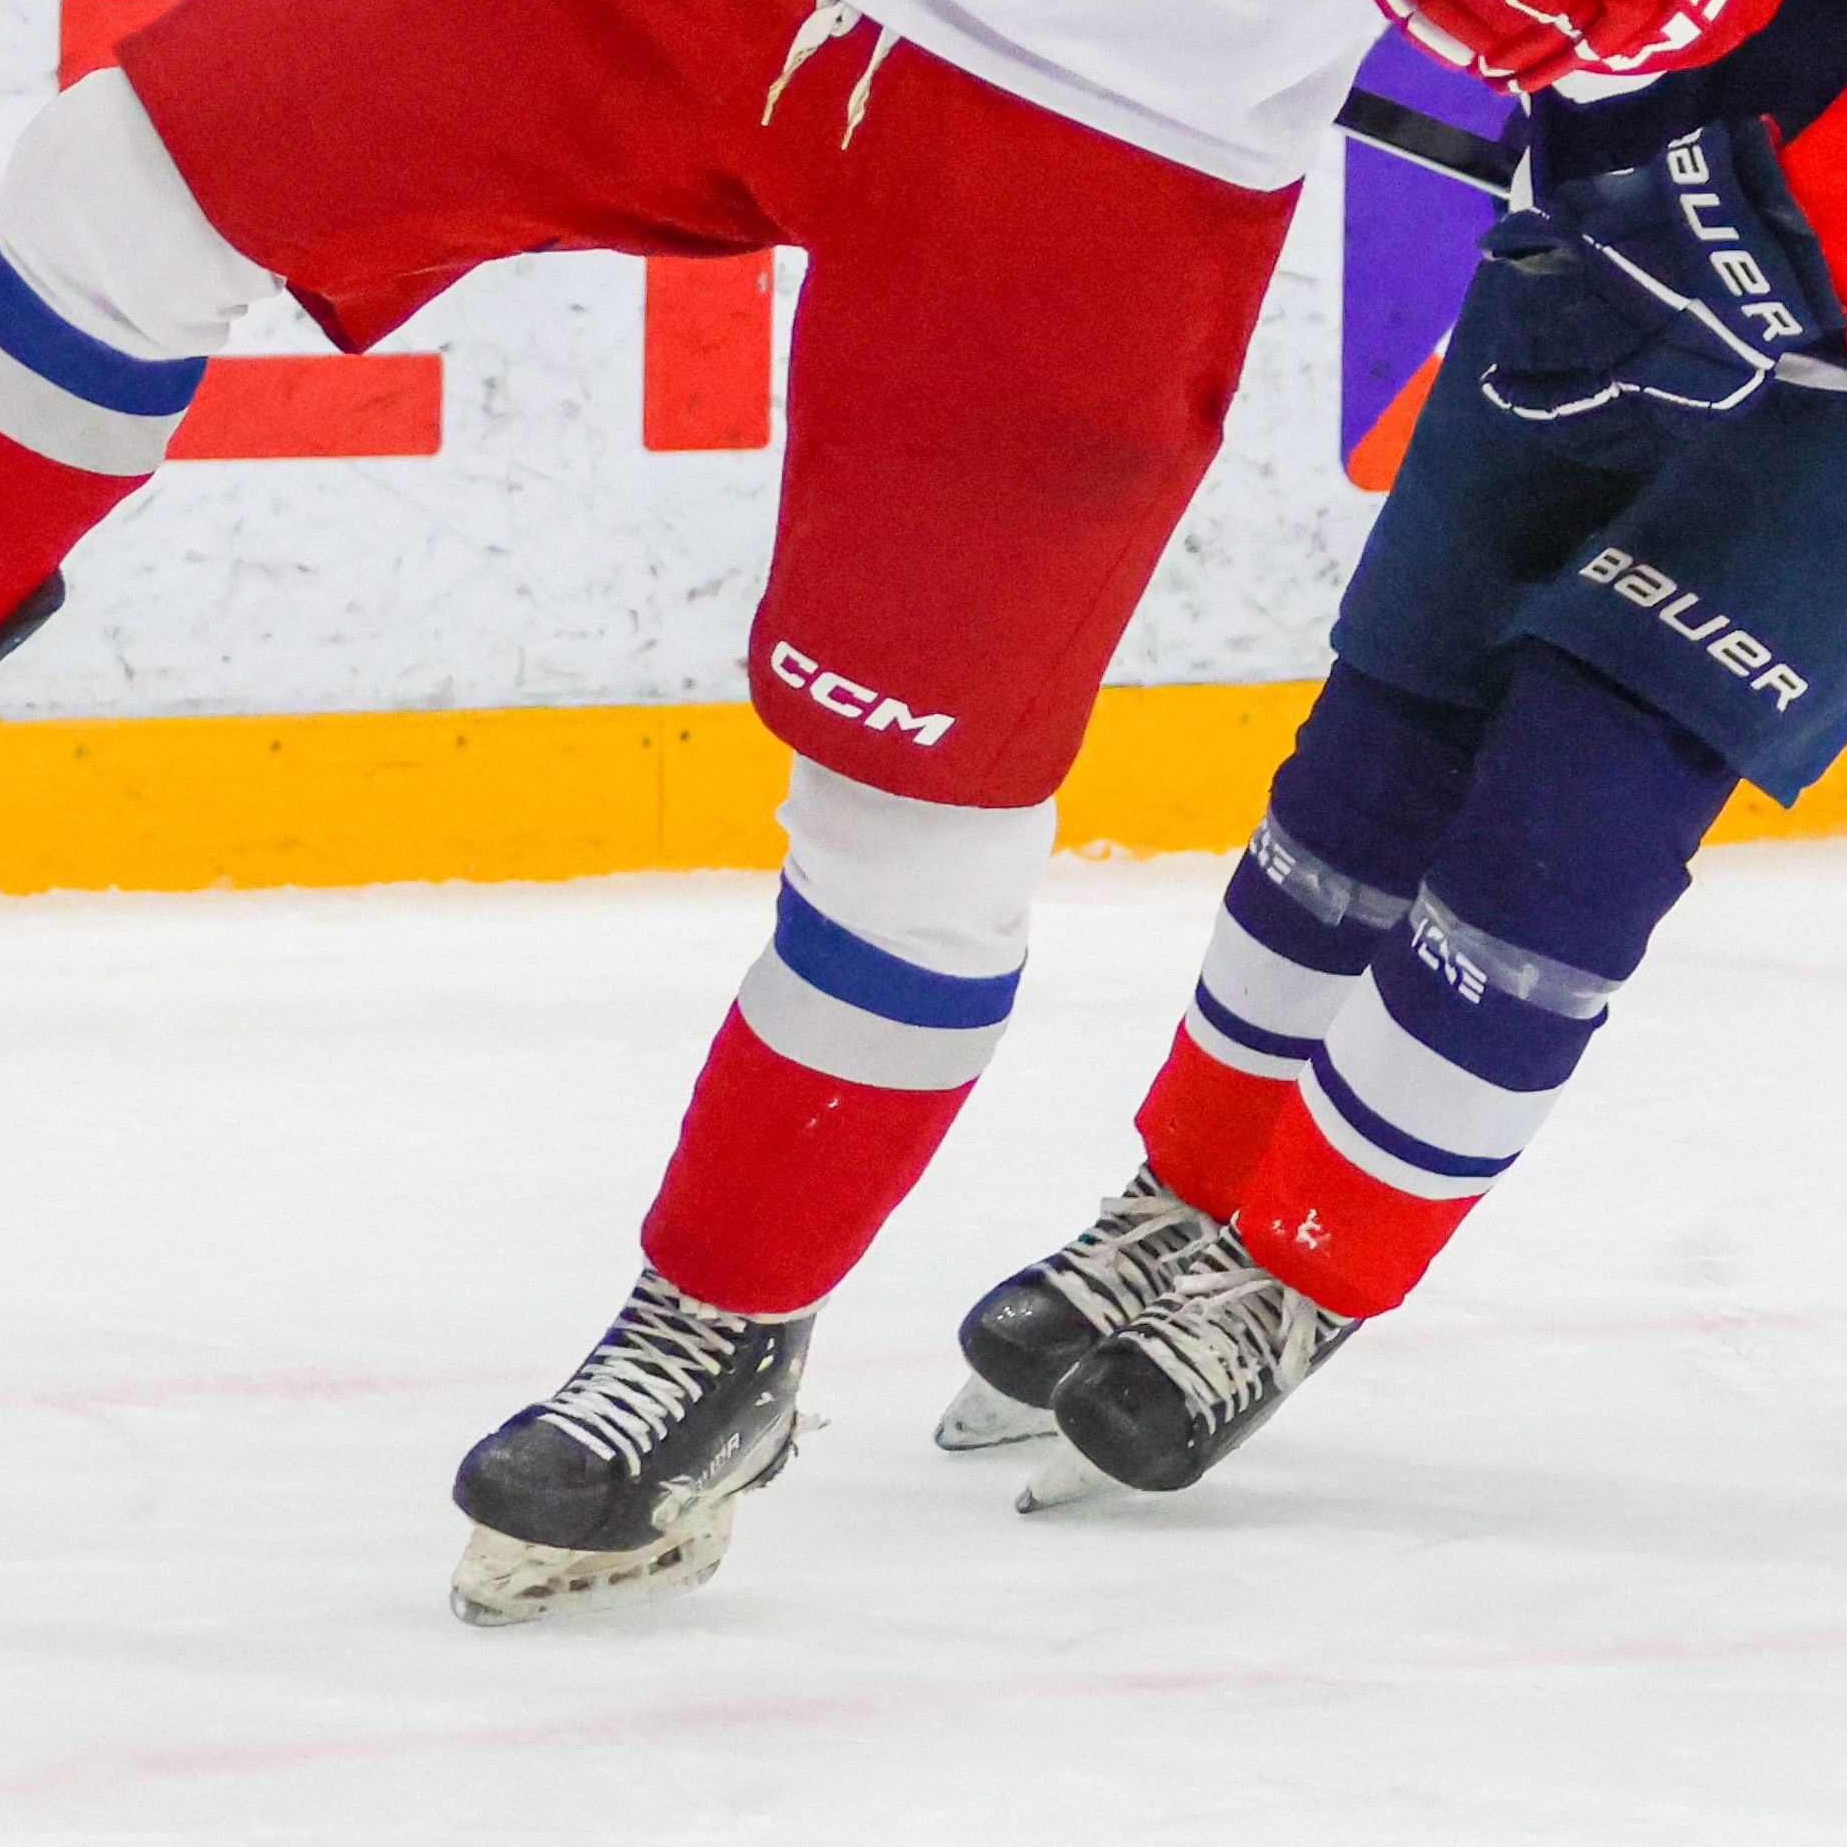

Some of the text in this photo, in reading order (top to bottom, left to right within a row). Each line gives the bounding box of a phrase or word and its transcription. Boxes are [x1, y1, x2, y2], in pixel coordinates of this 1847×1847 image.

[1665, 125, 1804, 343] AUER
[770, 639, 955, 748] CCM
[1579, 545, 1809, 712] BAUER
